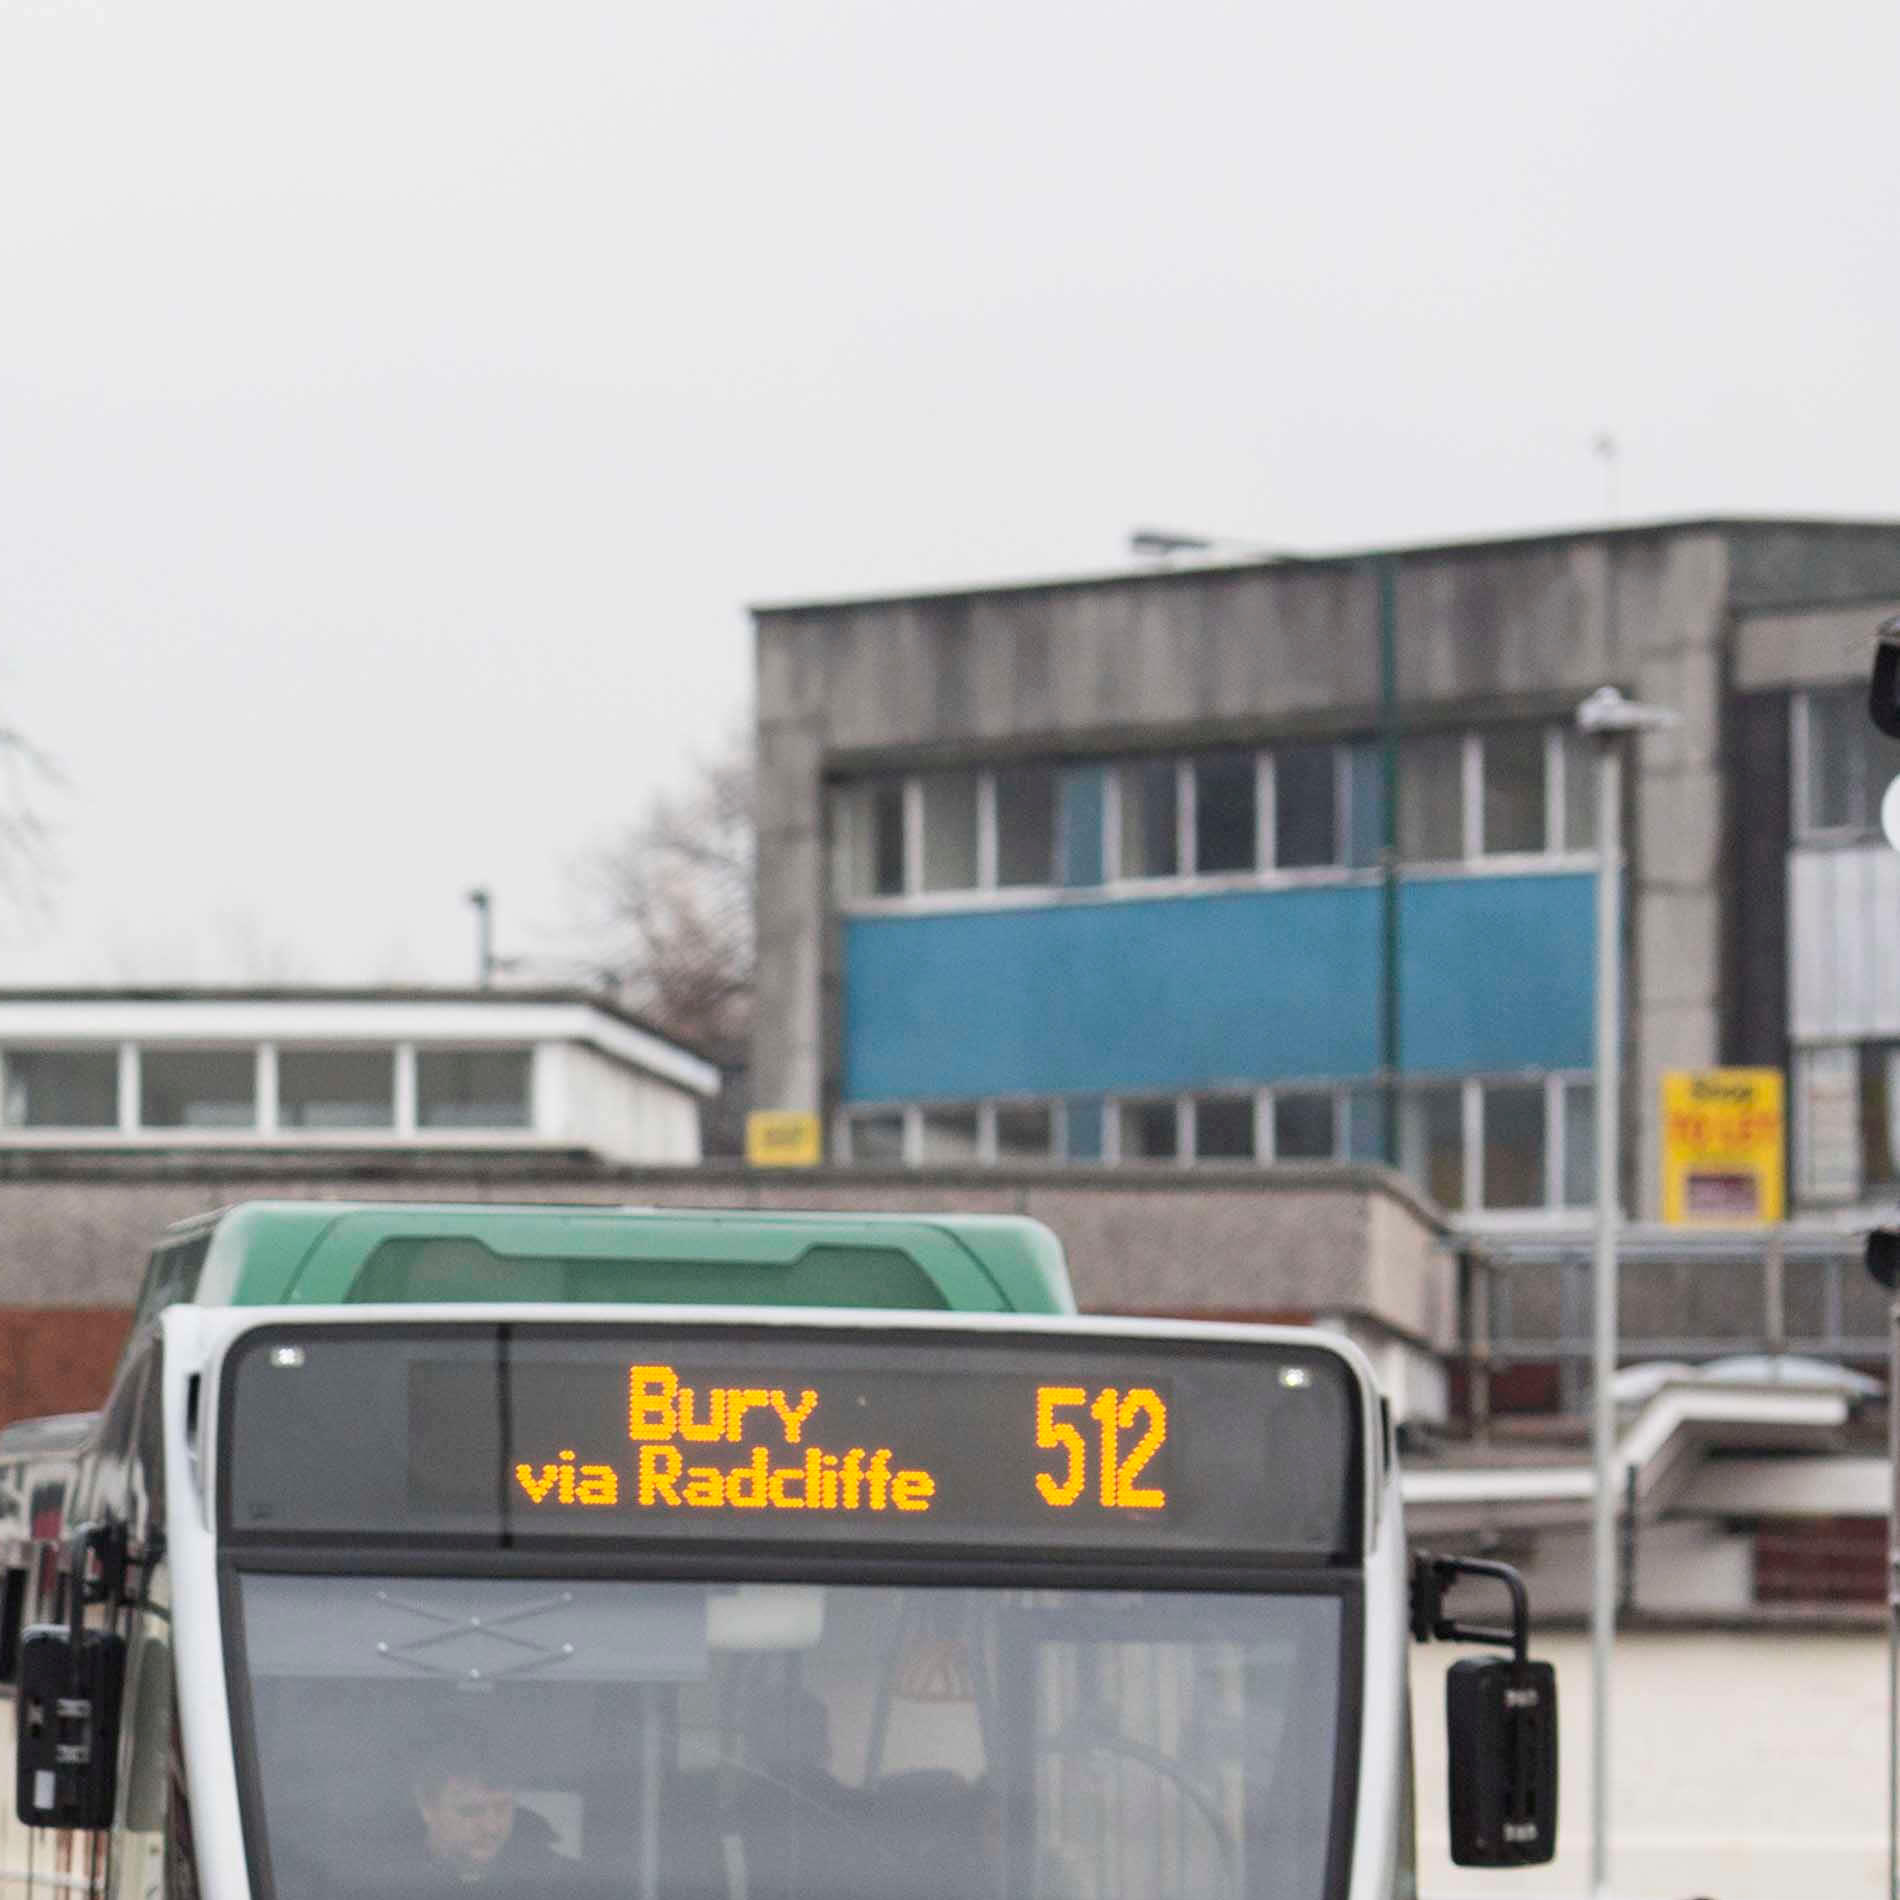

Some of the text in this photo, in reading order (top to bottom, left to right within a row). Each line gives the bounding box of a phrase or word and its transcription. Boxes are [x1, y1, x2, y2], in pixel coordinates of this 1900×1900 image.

[629, 1365, 818, 1443] Bury
[515, 1445, 935, 1511] via Radcliffe
[1035, 1387, 1167, 1509] 512
